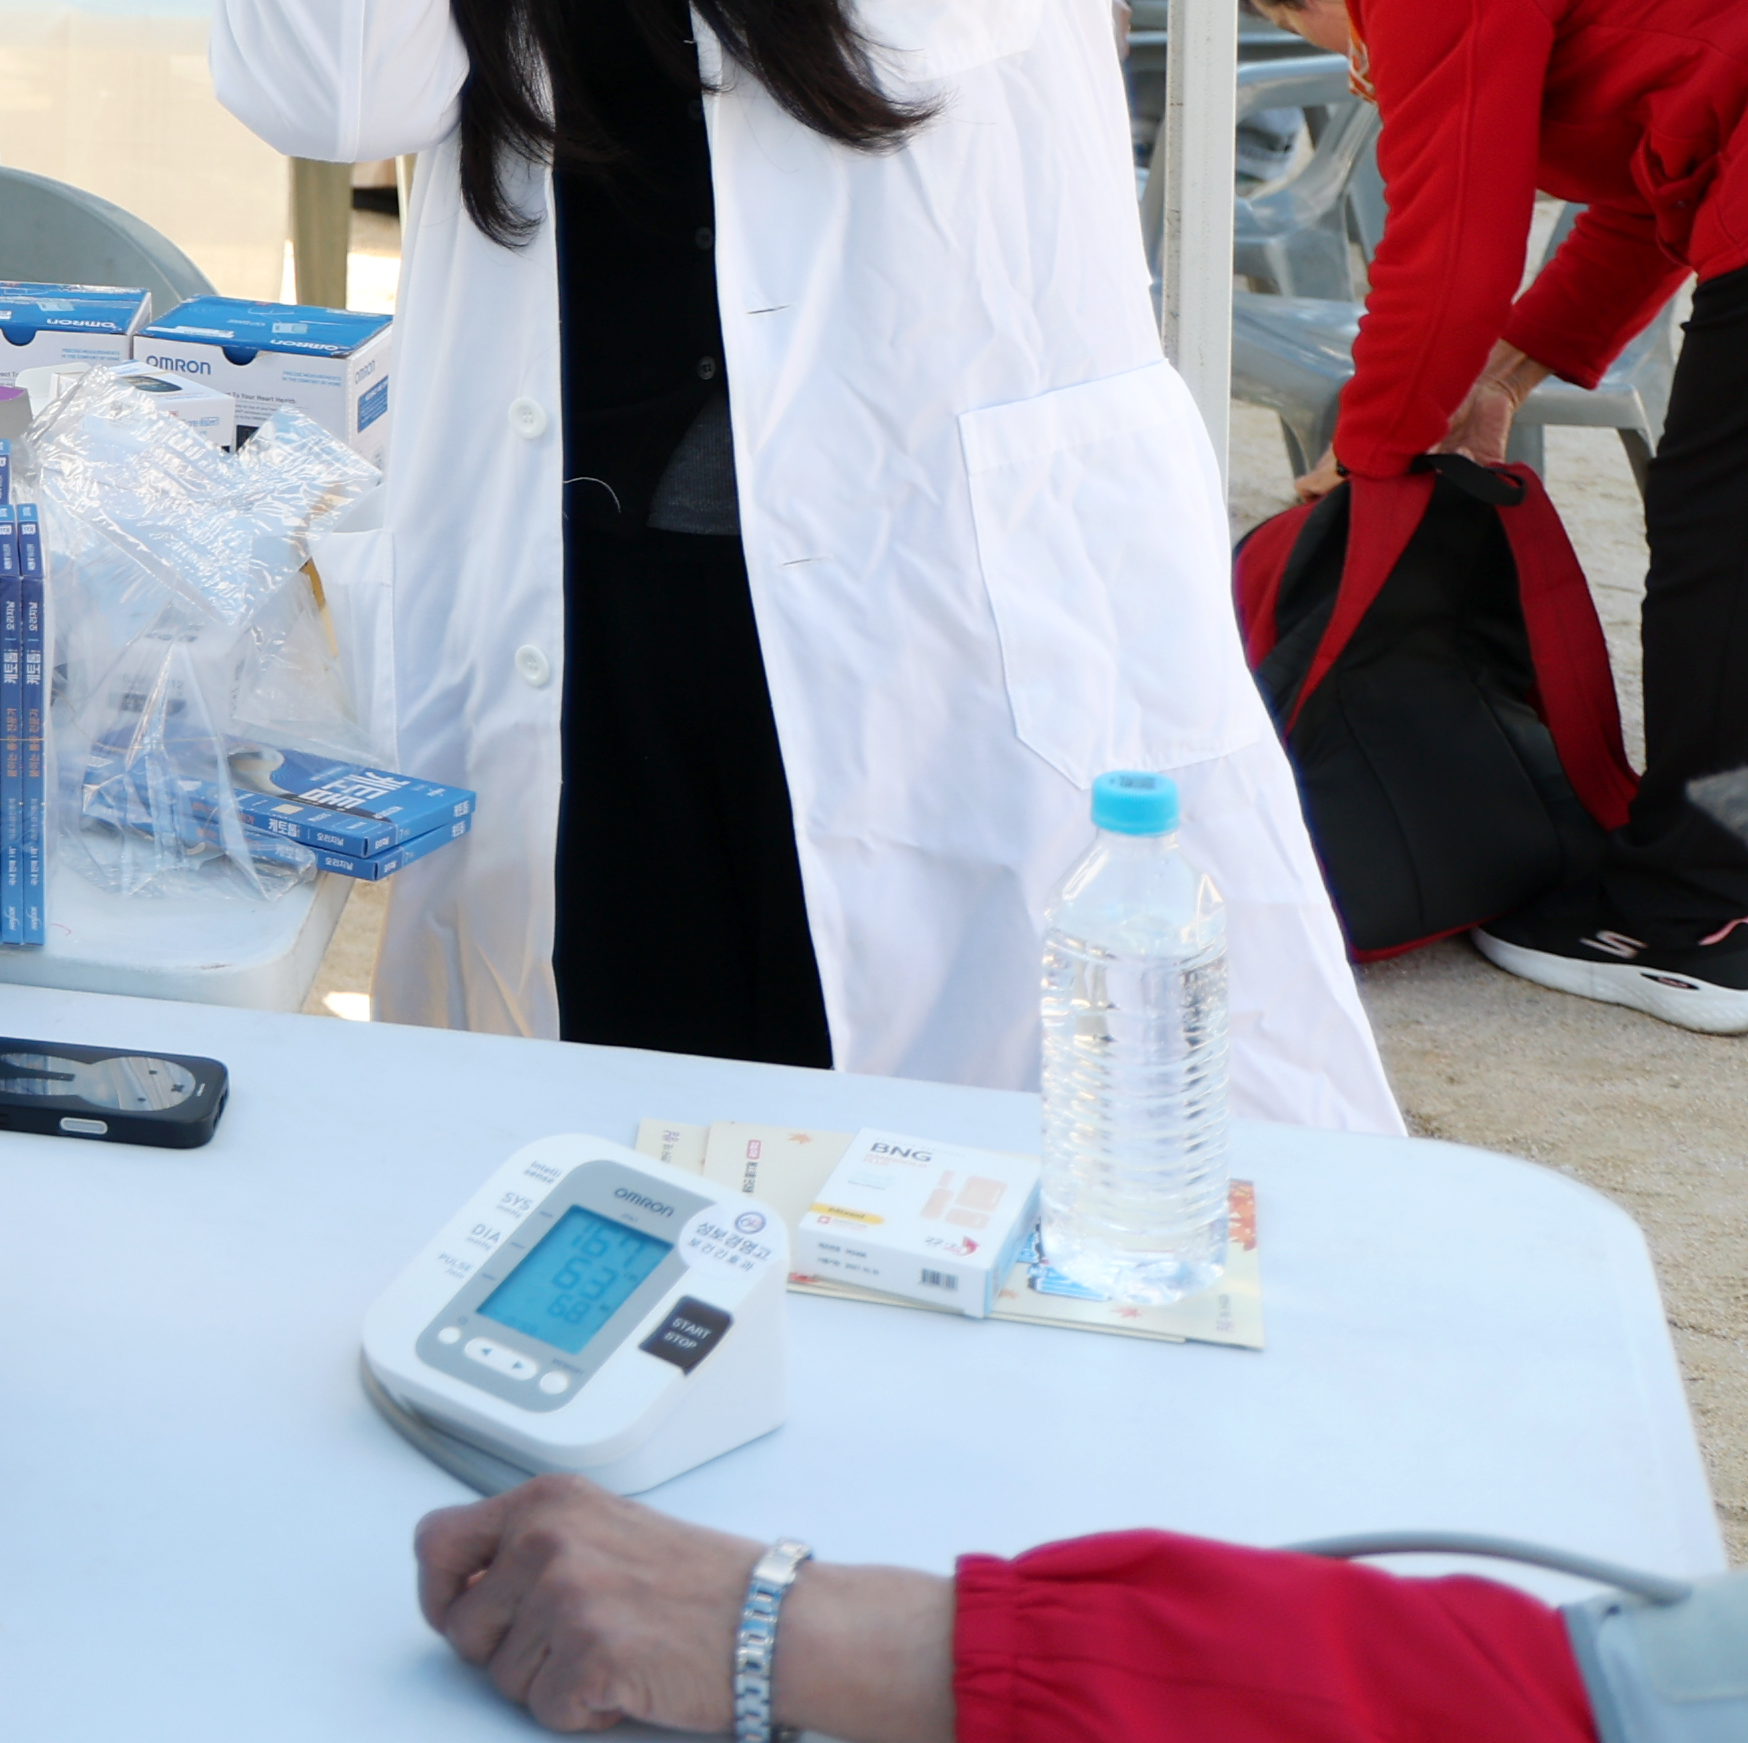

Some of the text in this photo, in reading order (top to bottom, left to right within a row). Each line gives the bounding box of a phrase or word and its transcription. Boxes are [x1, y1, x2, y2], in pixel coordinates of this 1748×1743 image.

[146, 355, 212, 375] OMRON
[317, 832, 344, 847] 오리지널
[325, 857, 354, 871] 오리지널
[870, 1142, 933, 1163] BNG
[501, 1191, 534, 1211] SYS
[614, 1187, 676, 1218] OMRON
[472, 1223, 501, 1243] DIA
[696, 1222, 771, 1259] 성보경영고
[438, 1253, 473, 1272] PULSE
[672, 1318, 712, 1339] START
[664, 1331, 698, 1350] STOP
